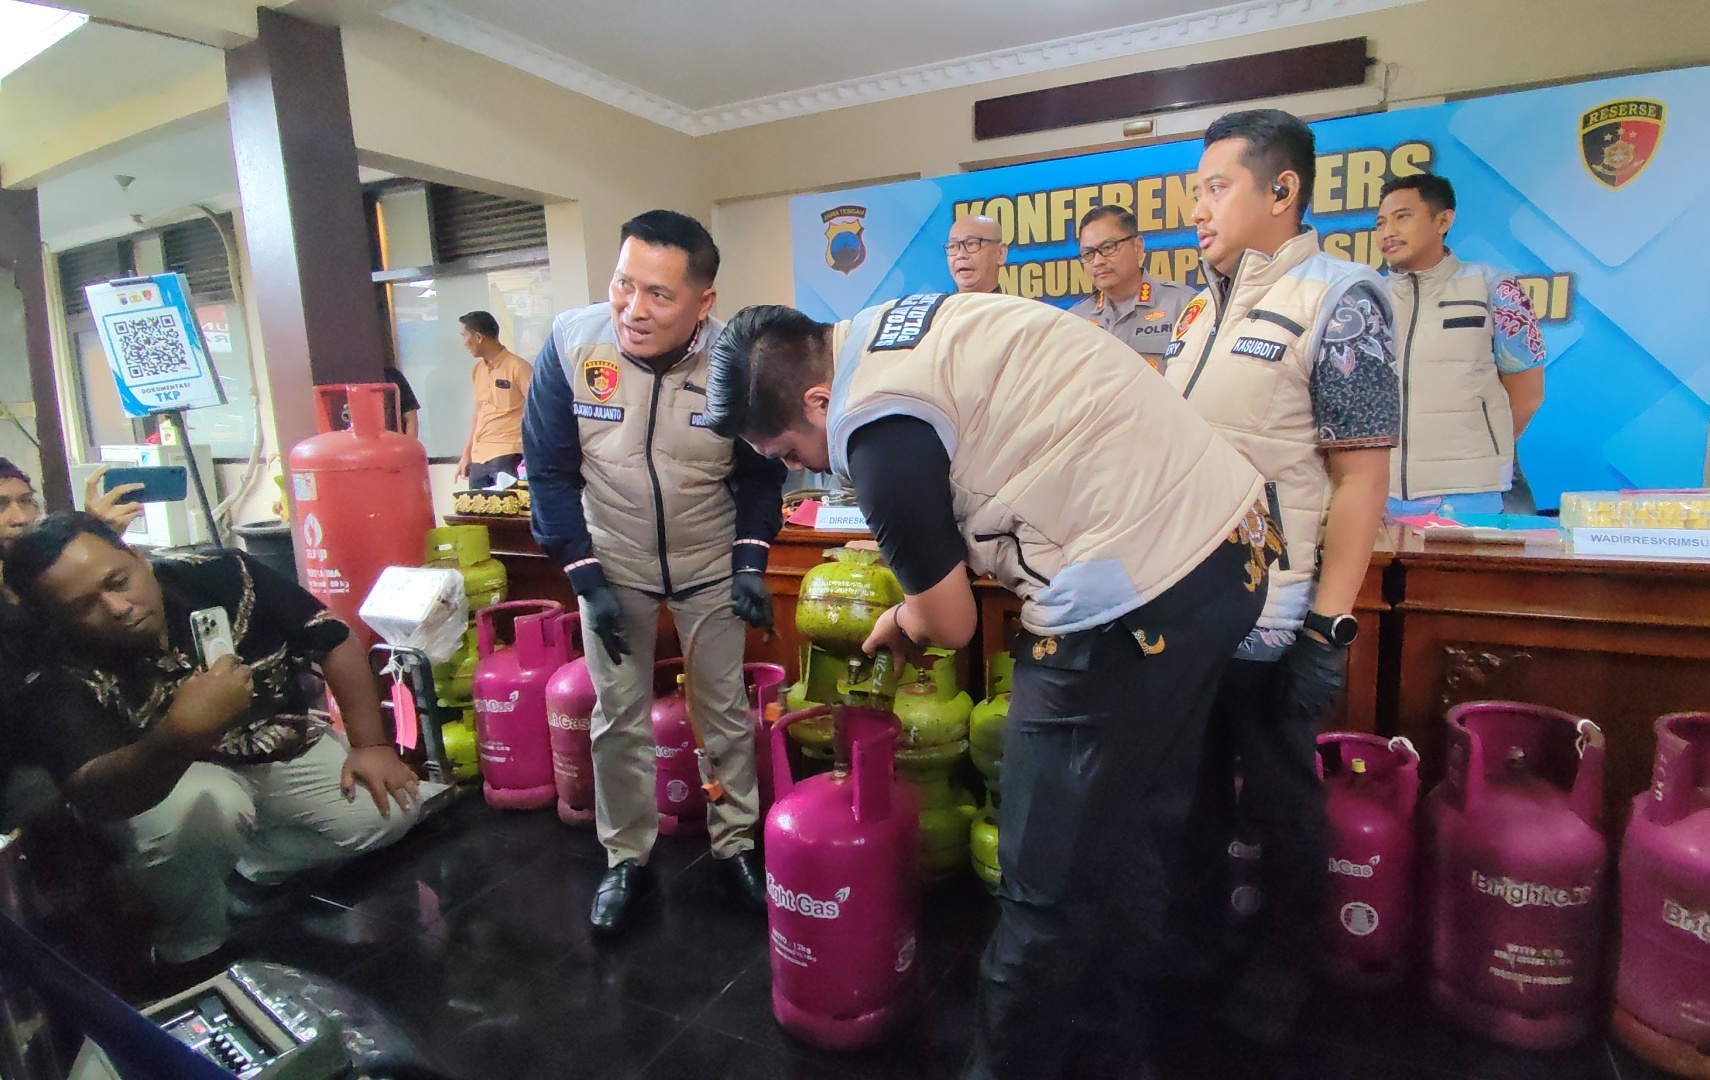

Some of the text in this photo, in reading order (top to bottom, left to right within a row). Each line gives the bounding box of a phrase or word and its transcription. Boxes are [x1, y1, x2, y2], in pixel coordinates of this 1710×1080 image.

[1588, 103, 1657, 126] RESERSE
[1312, 142, 1431, 214] ERS
[1135, 323, 1173, 336] POLRI
[1164, 341, 1181, 357] ERY
[1233, 339, 1281, 360] KASUBDIT
[141, 382, 191, 394] DOKUMENTASI
[155, 390, 181, 402] TKP
[593, 406, 622, 420] JULIANTO
[828, 516, 867, 525] DIRRESK
[1590, 533, 1710, 548] WADIRRESKRIMSU
